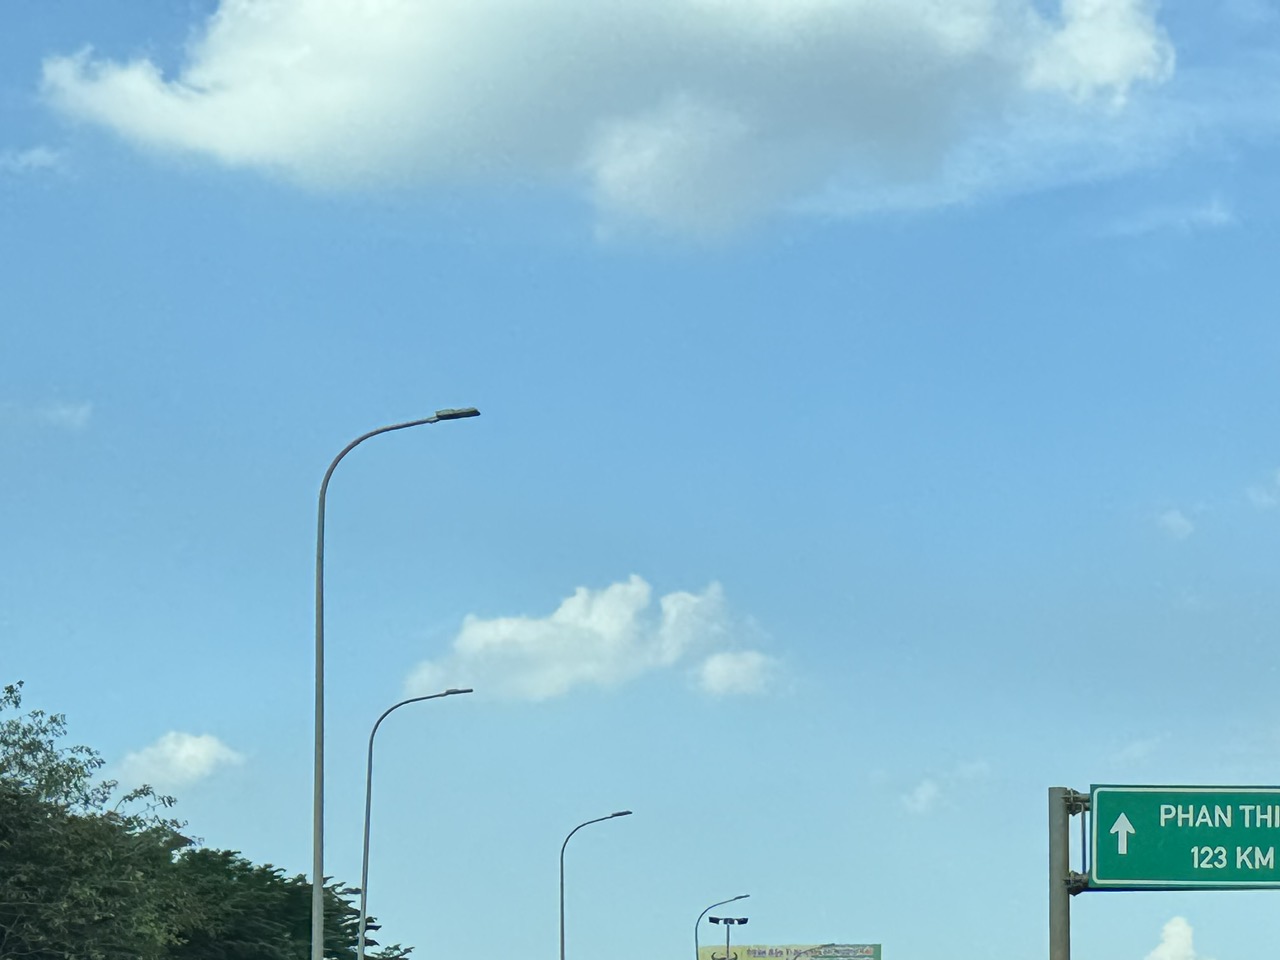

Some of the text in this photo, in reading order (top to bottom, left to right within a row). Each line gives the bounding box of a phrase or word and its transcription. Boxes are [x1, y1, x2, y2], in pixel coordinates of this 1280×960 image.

[1160, 804, 1232, 828] PHAN
[1191, 846, 1275, 869] 123 KM
